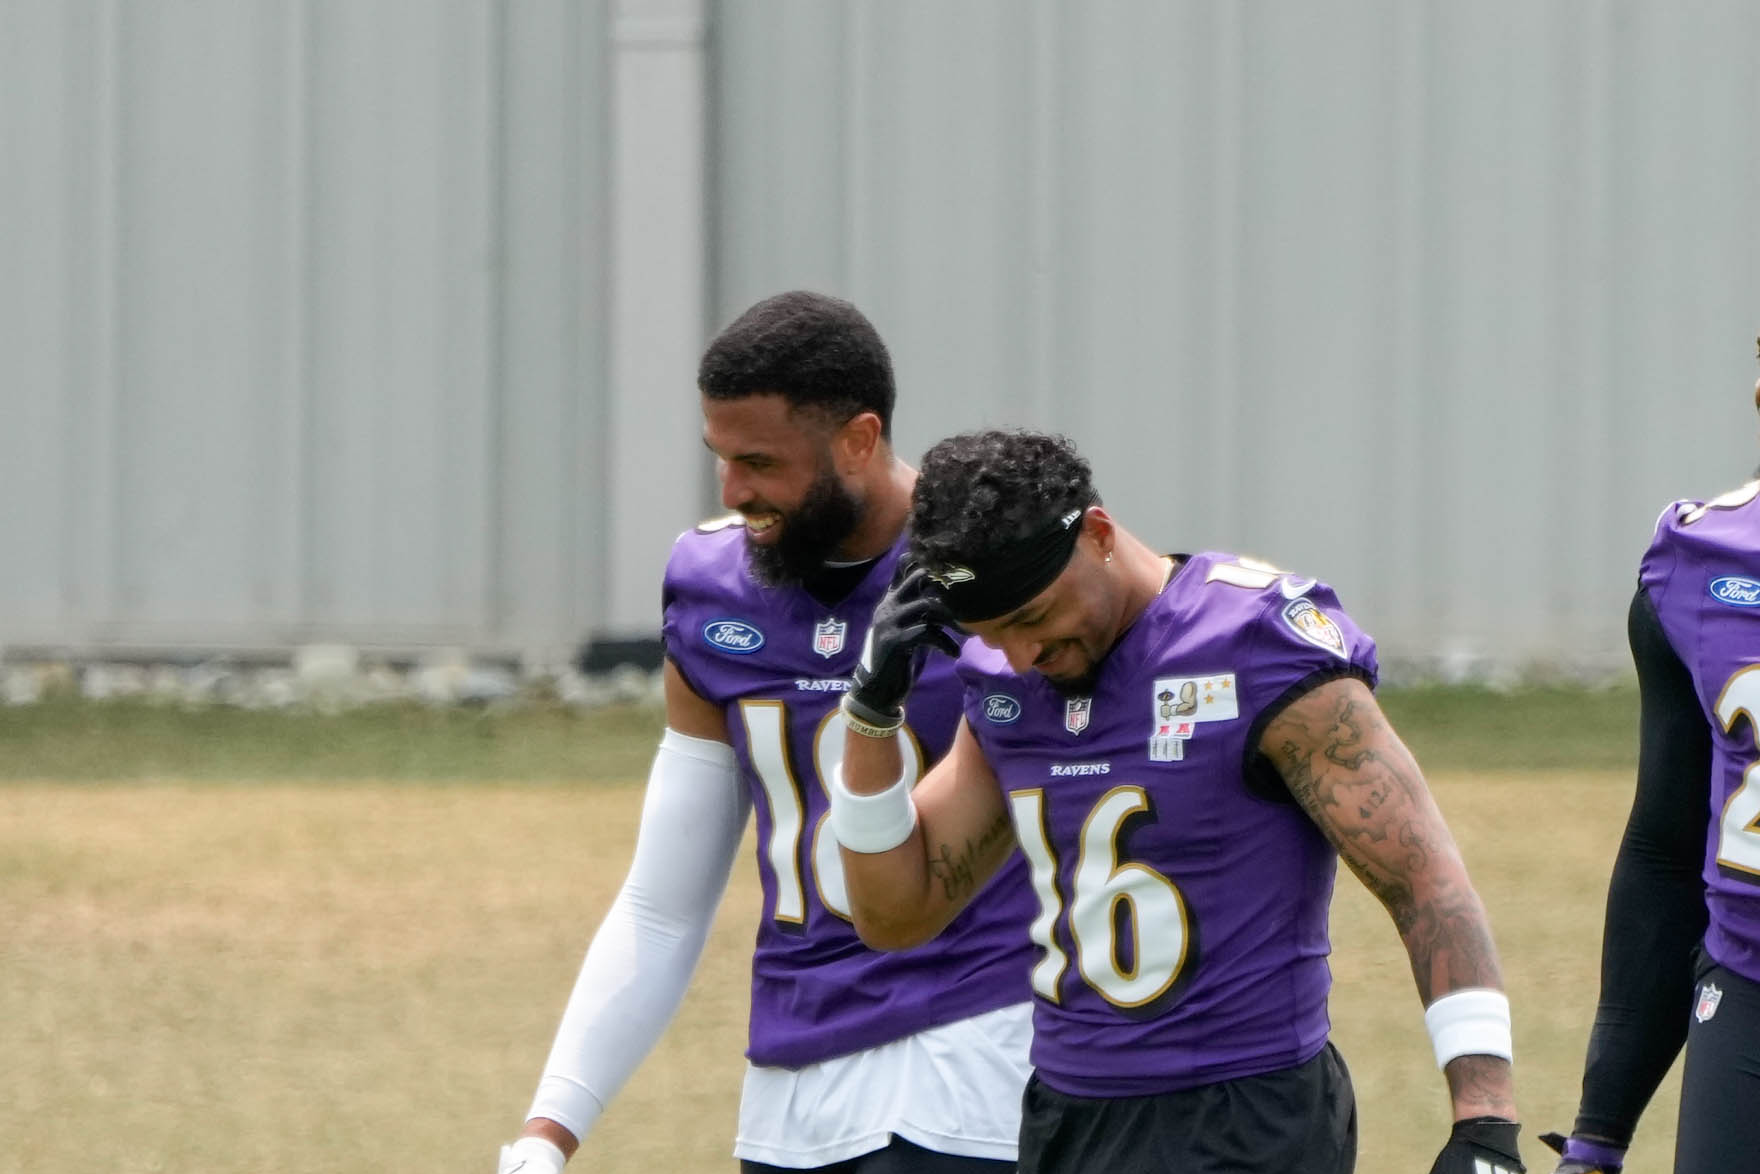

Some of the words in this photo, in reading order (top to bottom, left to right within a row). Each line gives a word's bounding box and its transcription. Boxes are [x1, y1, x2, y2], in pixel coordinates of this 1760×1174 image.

[1719, 580, 1760, 602] Ford
[714, 624, 752, 647] Ford
[819, 636, 839, 649] NFL
[795, 680, 852, 692] RAVEN
[986, 697, 1012, 719] Ford
[1070, 712, 1085, 727] NFL
[1050, 763, 1111, 777] RAVENS
[1008, 785, 1189, 1009] 16
